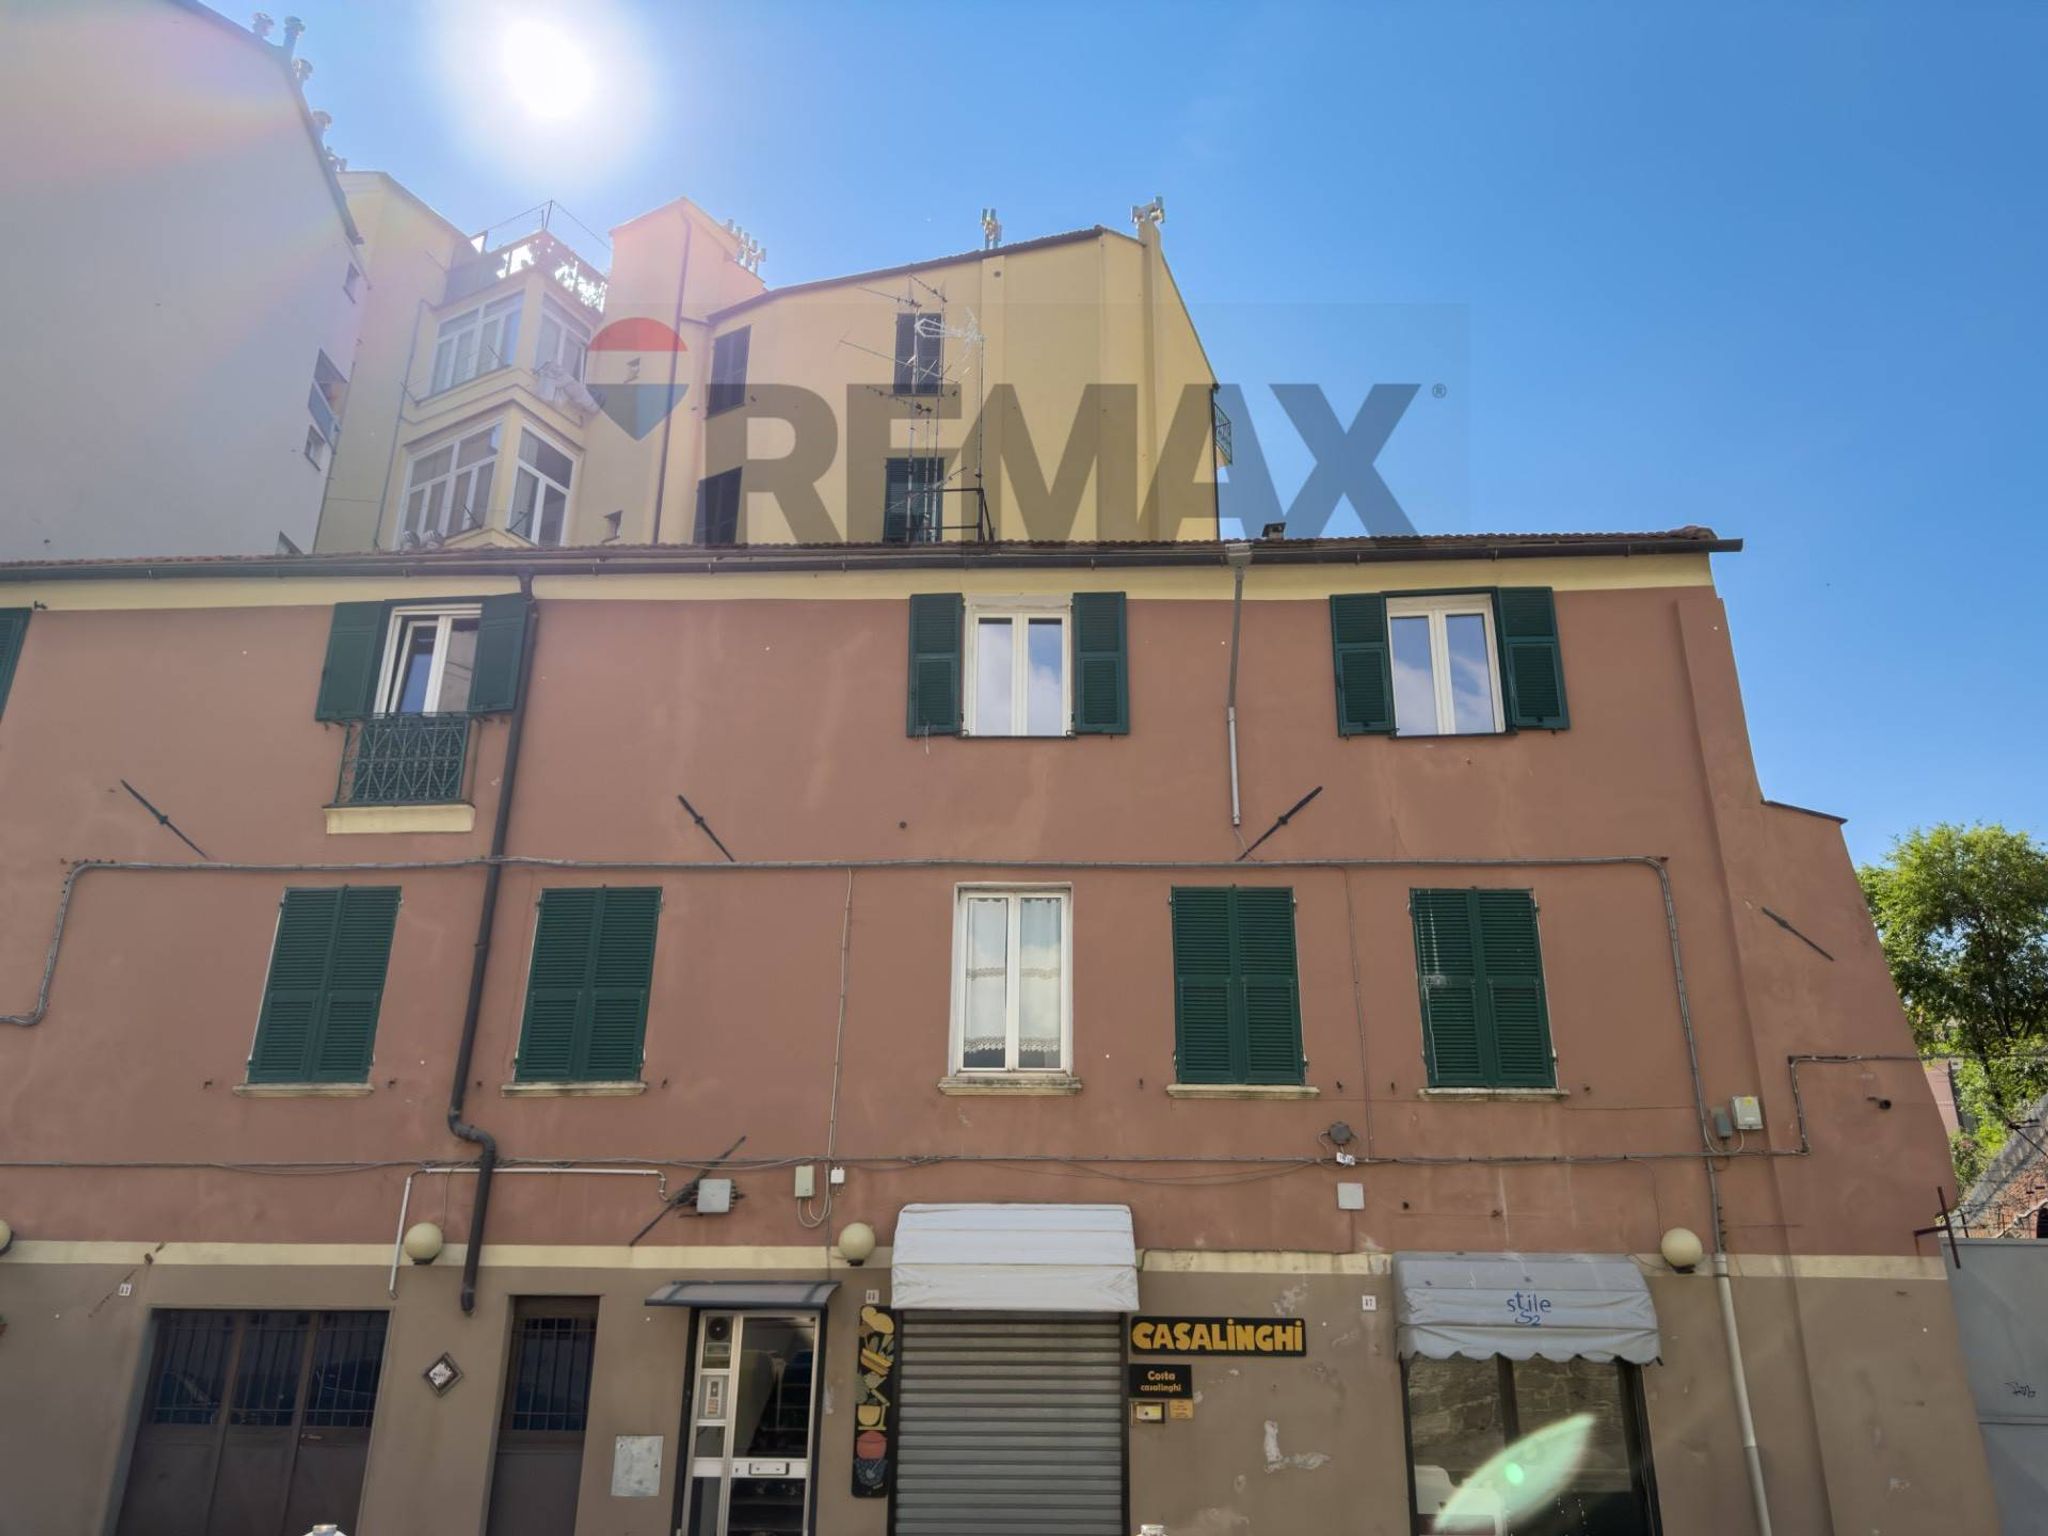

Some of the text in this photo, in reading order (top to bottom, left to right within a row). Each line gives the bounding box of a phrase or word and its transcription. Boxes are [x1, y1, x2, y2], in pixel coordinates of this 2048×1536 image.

[1506, 1291, 1551, 1312] stile
[1147, 1371, 1176, 1381] Costa
[1140, 1383, 1182, 1393] casalinghi
